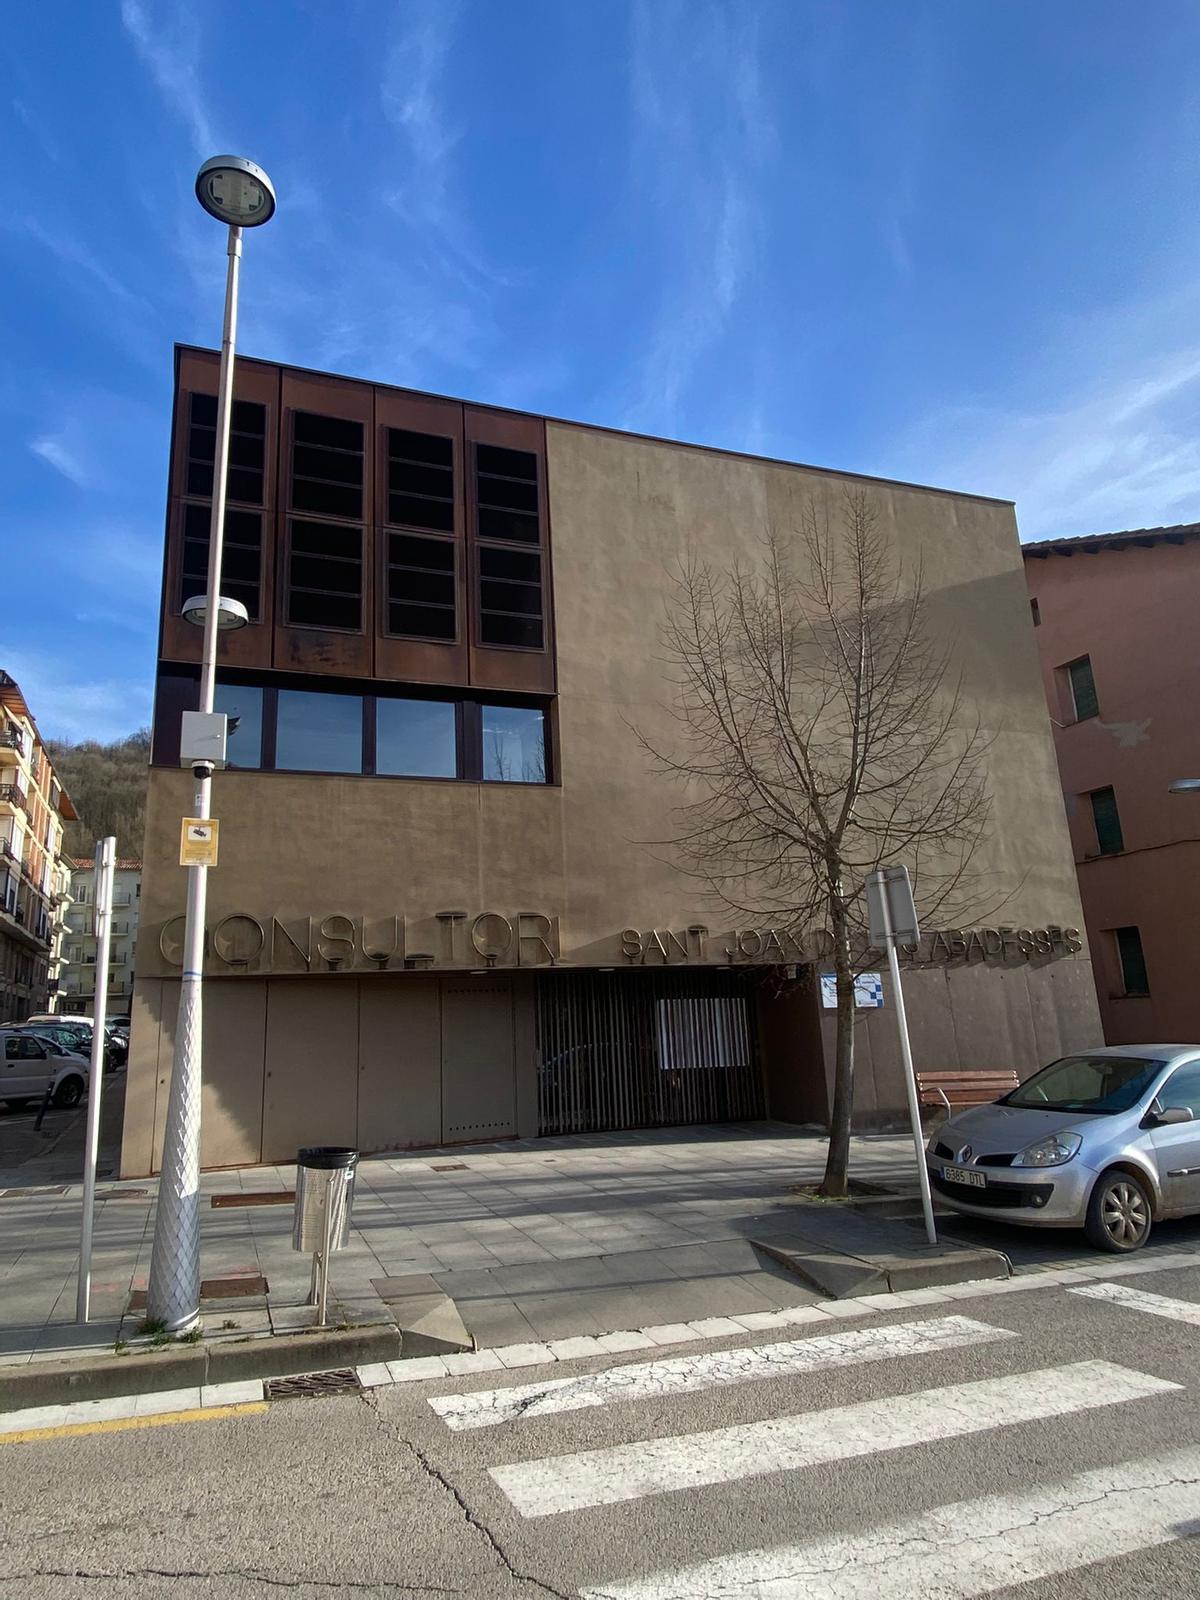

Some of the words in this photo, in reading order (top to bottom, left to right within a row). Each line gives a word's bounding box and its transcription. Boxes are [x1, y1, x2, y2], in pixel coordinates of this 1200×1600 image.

[159, 912, 561, 967] CONSULTORI
[621, 925, 708, 958] SANT
[725, 928, 806, 957] JOAN
[931, 926, 1083, 956] ABADESSES
[969, 1172, 985, 1187] DTL
